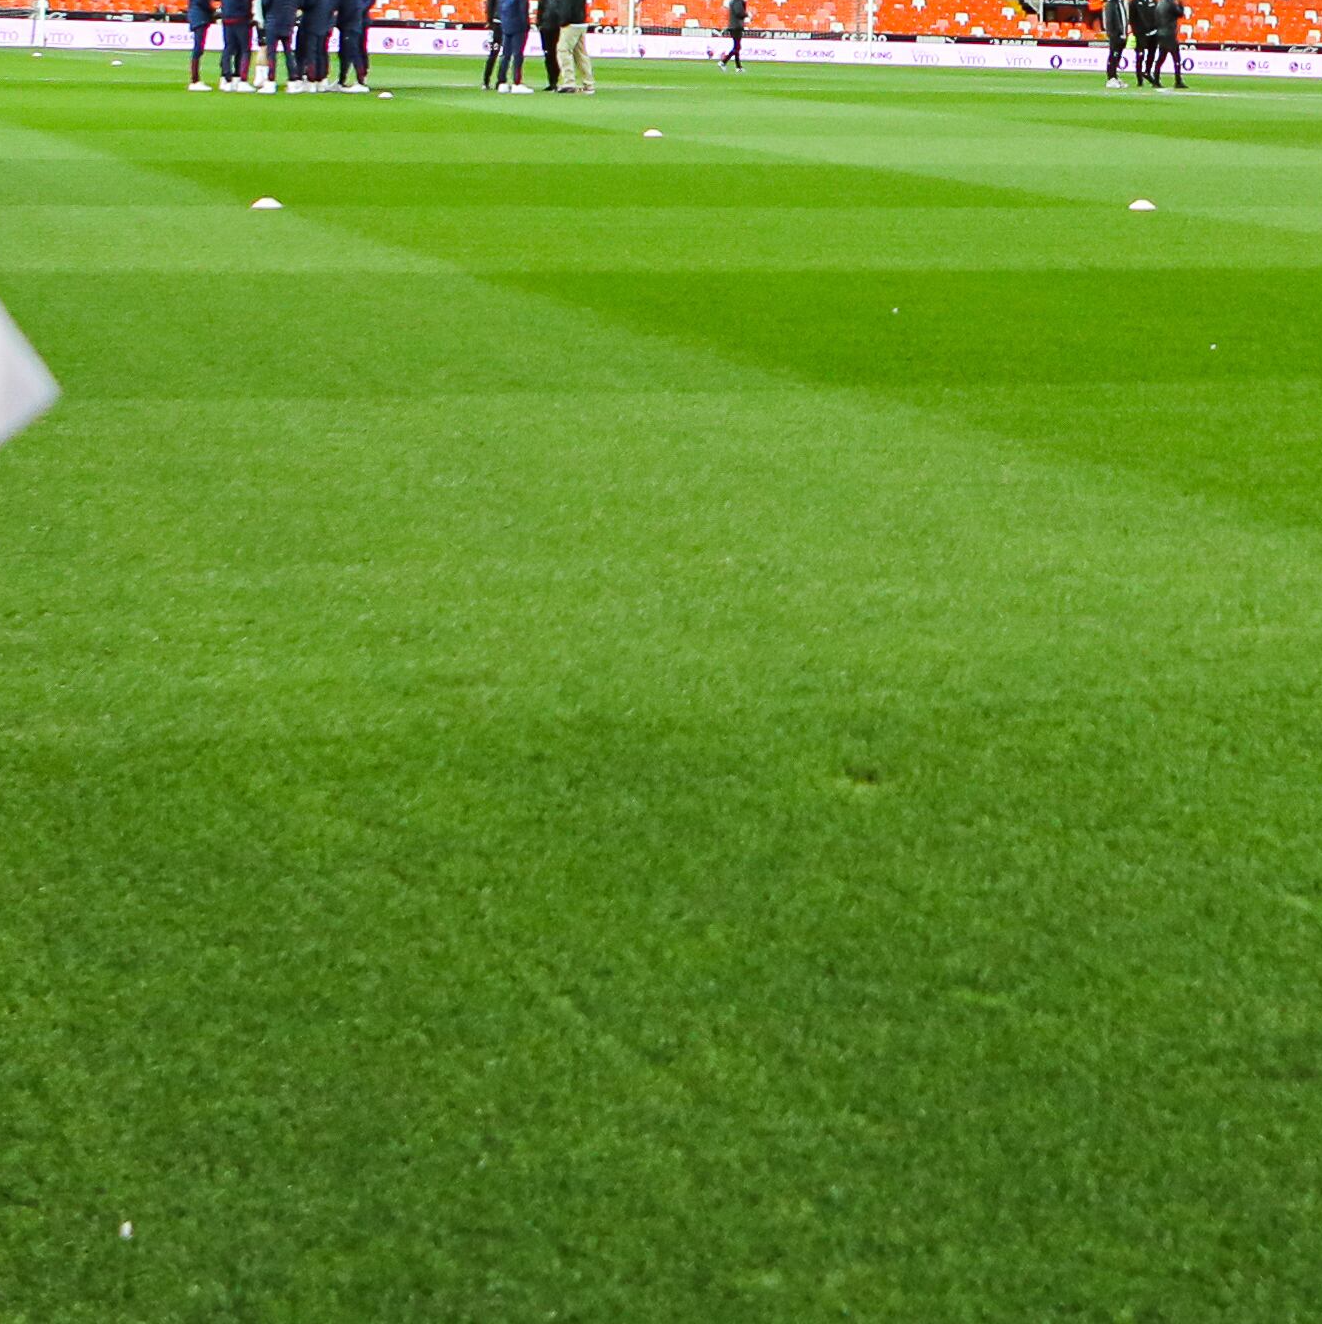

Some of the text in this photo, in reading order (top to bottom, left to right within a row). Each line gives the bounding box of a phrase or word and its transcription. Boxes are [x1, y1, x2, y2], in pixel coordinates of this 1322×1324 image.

[396, 38, 410, 47] LG
[446, 39, 459, 48] LG
[1258, 61, 1269, 69] LG
[1300, 63, 1312, 71] LG
